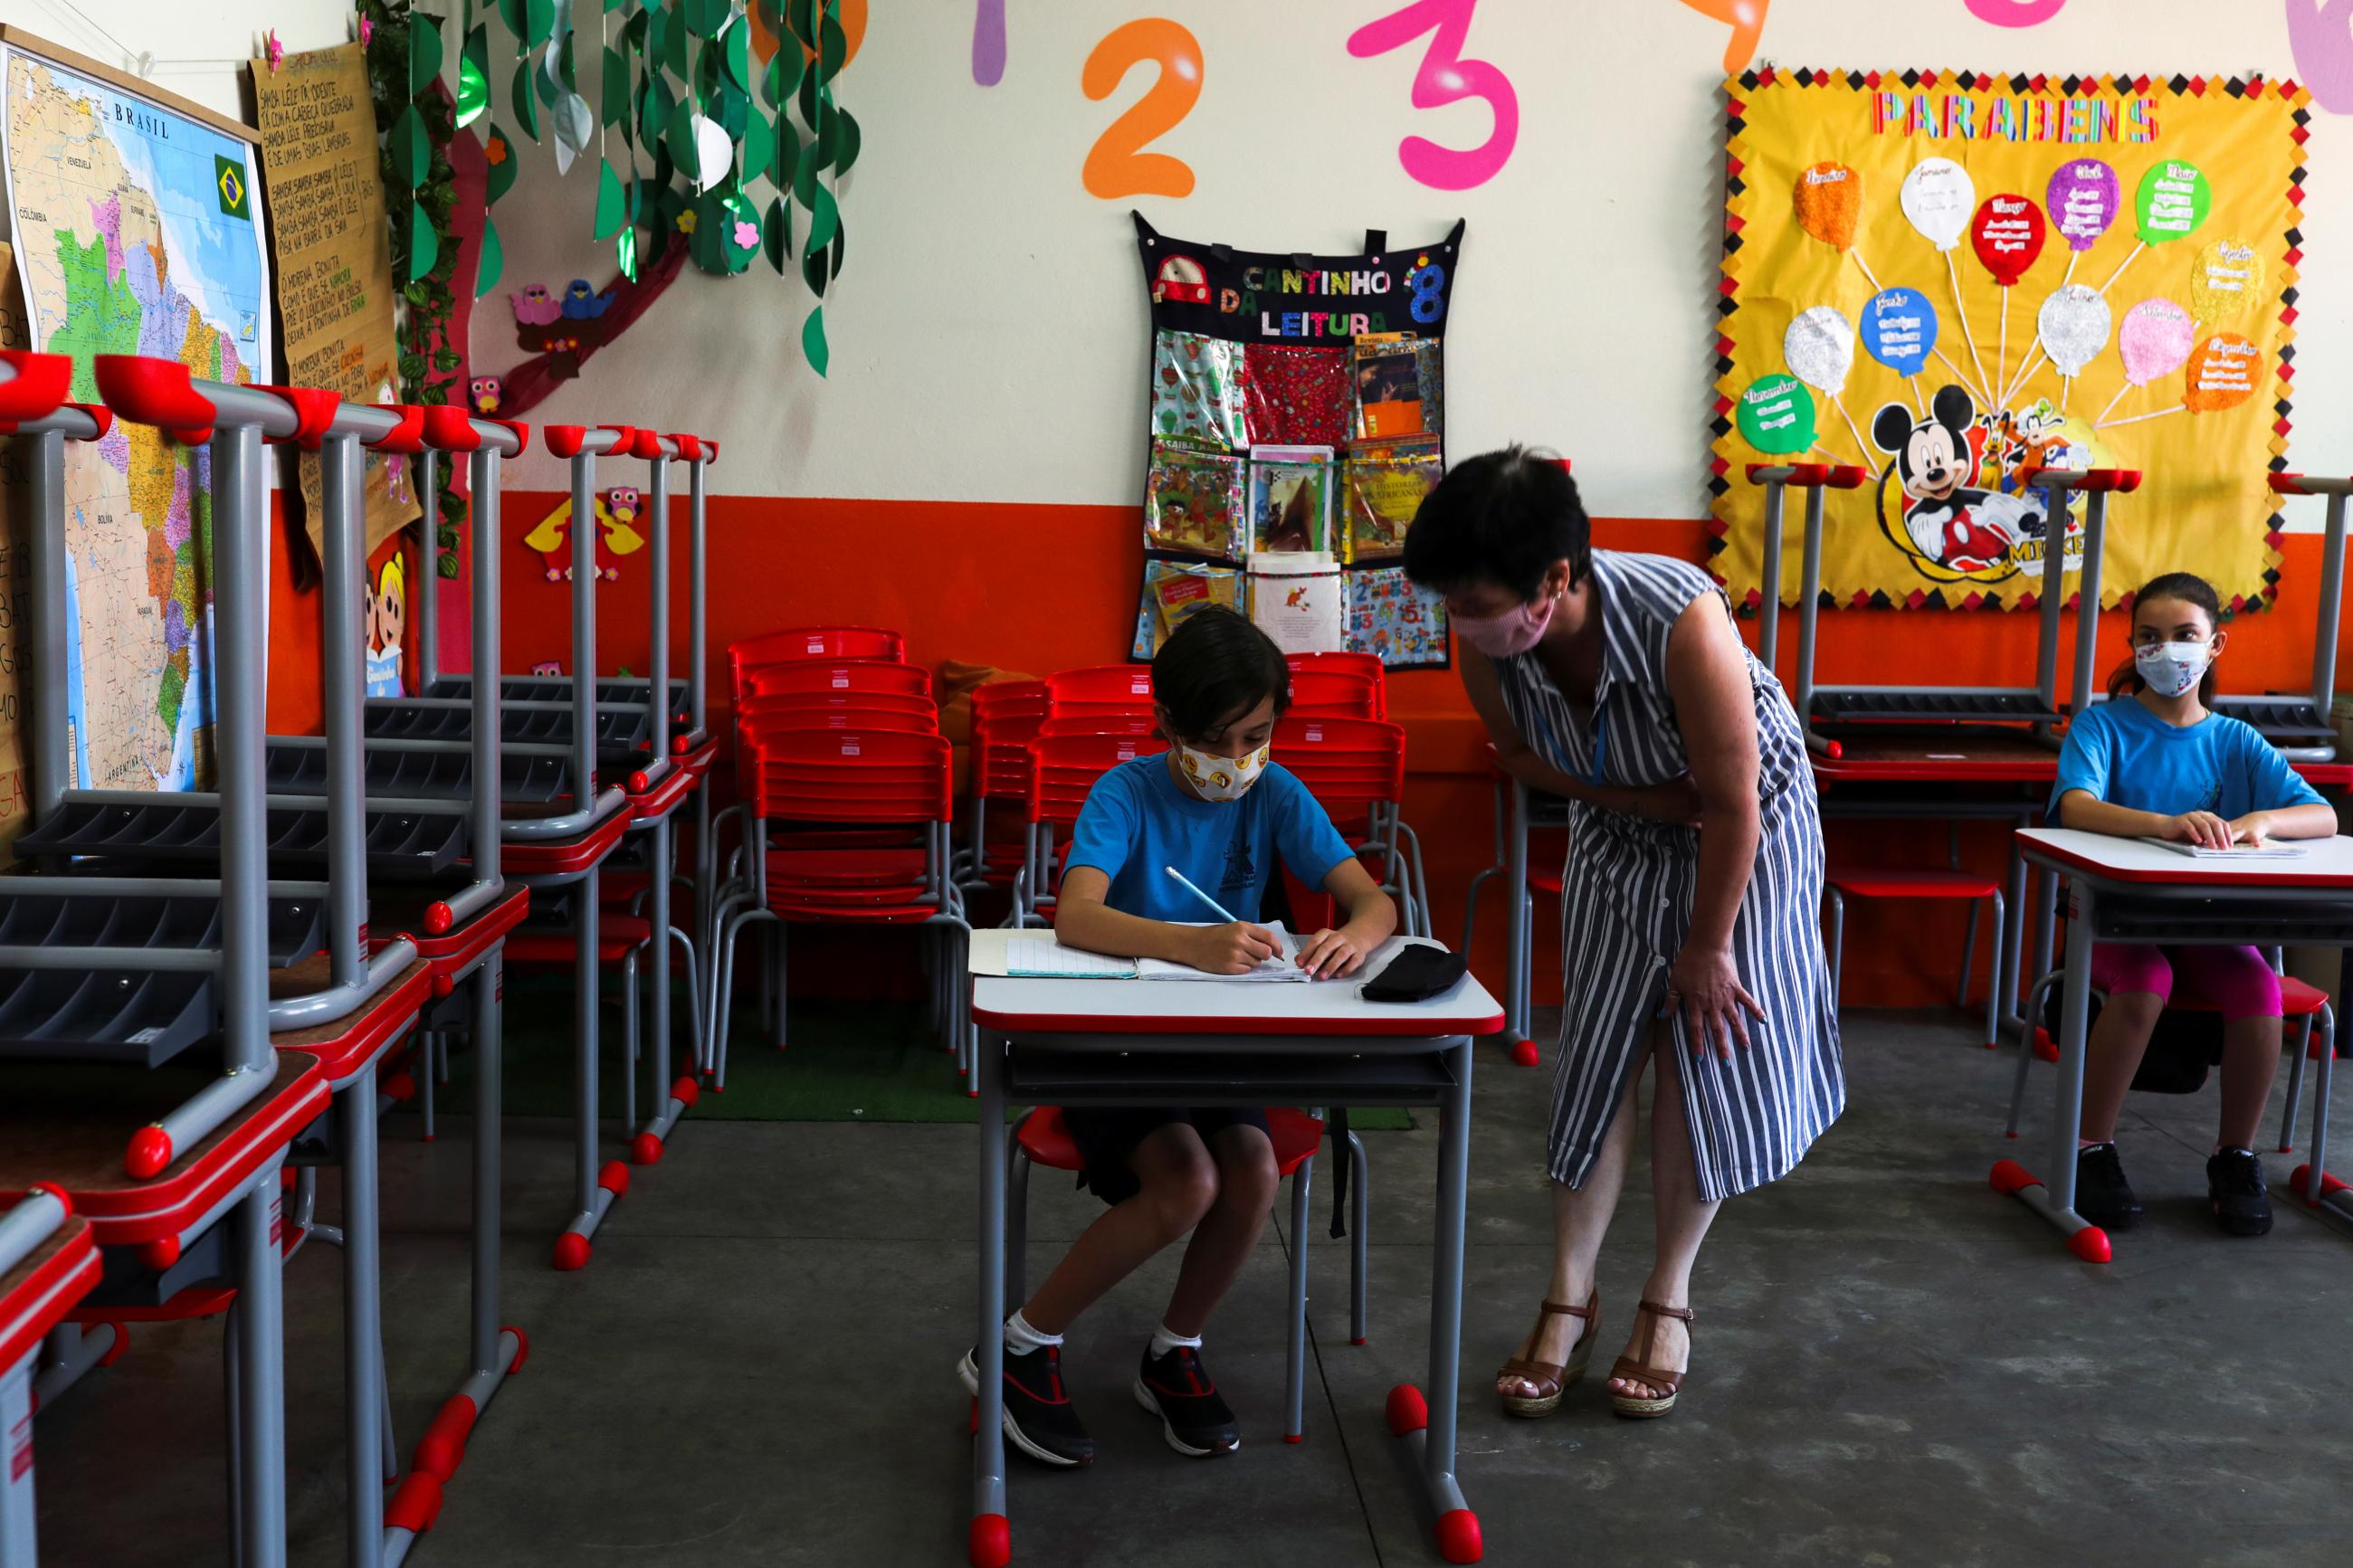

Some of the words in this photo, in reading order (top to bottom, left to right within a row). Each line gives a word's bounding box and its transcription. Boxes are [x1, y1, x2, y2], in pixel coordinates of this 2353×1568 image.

[1081, 17, 1205, 199] 2
[1347, 0, 1519, 191] 3
[115, 103, 169, 139] BRASIL
[1870, 91, 2160, 143] PARABENS
[66, 157, 91, 170] VENEZUELA
[19, 207, 47, 223] COLÔMBIA
[315, 255, 340, 279] BONITA
[1243, 267, 1391, 295] CANTINHO
[1221, 288, 1258, 316] DA
[1262, 311, 1387, 337] LEITURA
[1166, 440, 1195, 450] SAIBA
[107, 754, 140, 783] ARGENTINA
